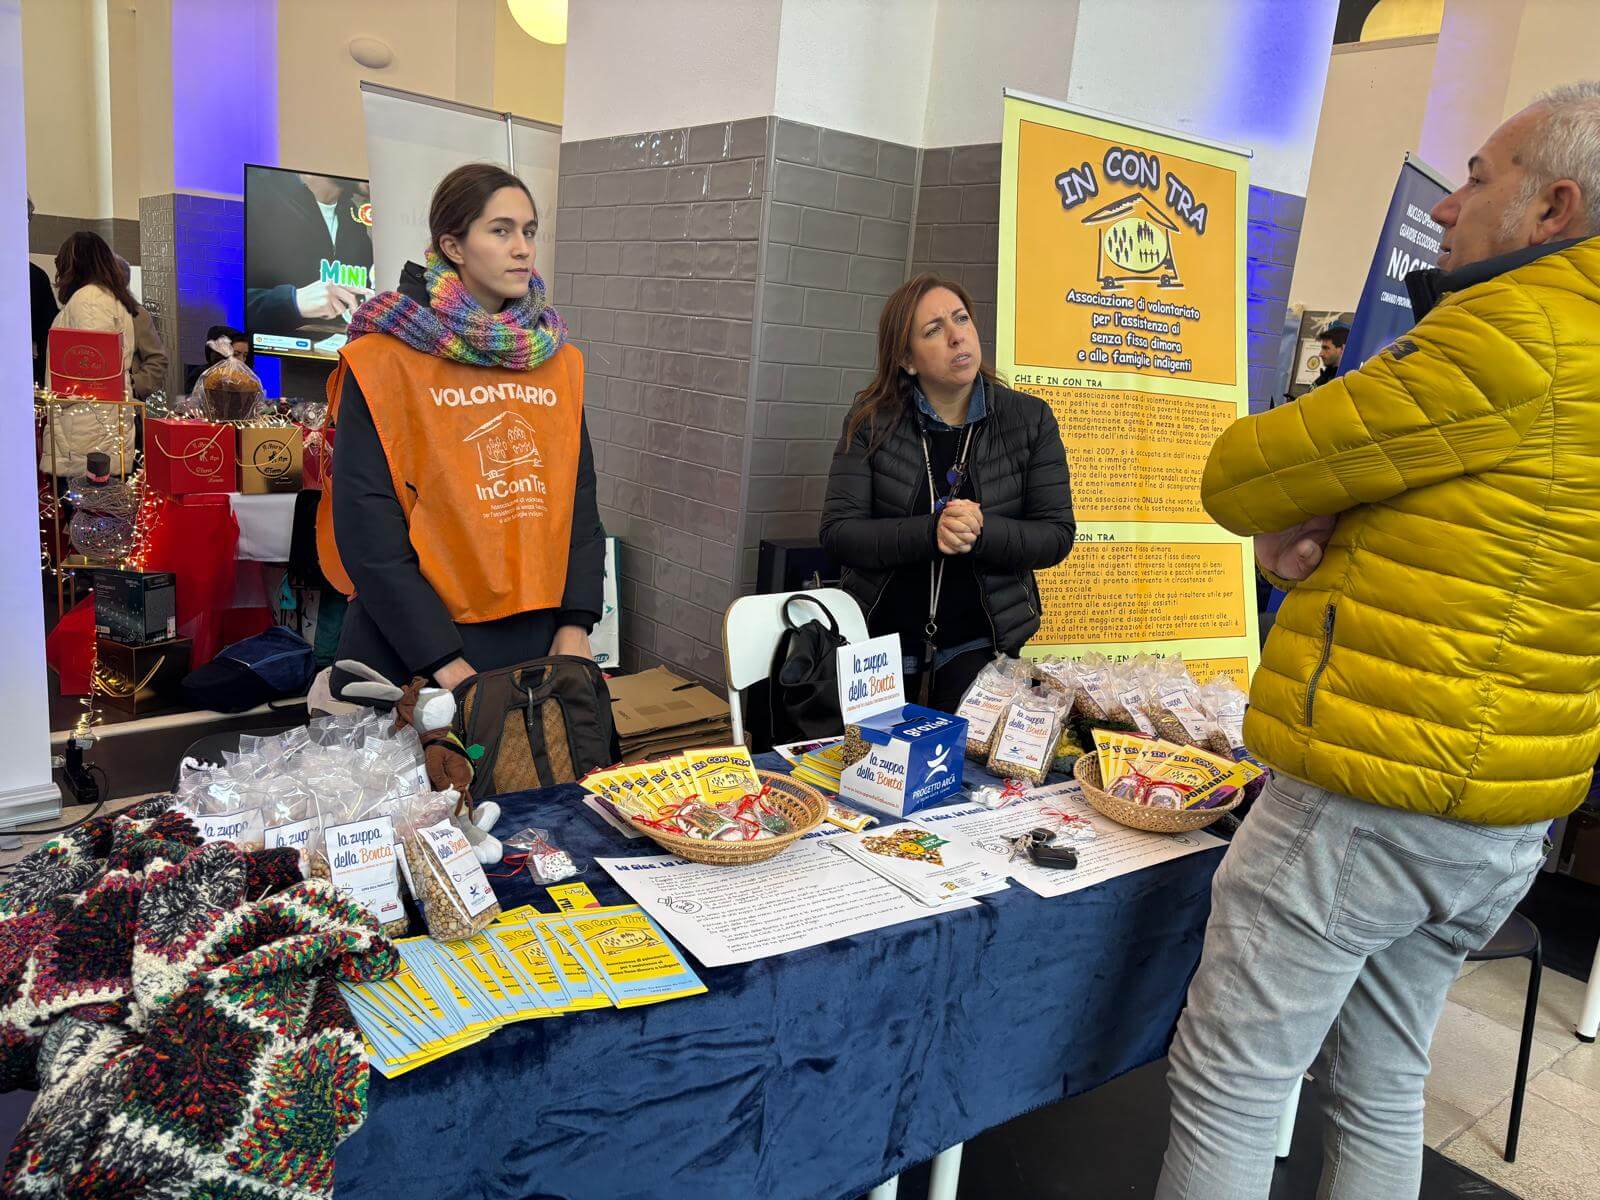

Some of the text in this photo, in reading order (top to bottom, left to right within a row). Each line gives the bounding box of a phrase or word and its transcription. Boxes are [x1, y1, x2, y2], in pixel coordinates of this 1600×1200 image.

[1056, 146, 1208, 236] IN CON TRA
[1066, 290, 1200, 320] Associazione di volontariato
[1092, 312, 1180, 334] per l'assistenza ai
[1091, 332, 1182, 353] senza fissa dimora
[1078, 350, 1192, 373] e alle famiglie indigenti
[1015, 374, 1031, 382] CHI
[1047, 376, 1058, 385] IN
[1063, 378, 1082, 386] CON
[429, 383, 557, 407] VOLONTARIO
[476, 474, 546, 500] InConTra
[854, 652, 888, 674] la zuppa
[849, 672, 896, 702] della Bontà
[692, 761, 707, 772] IN
[731, 758, 750, 766] TRA
[869, 752, 904, 775] la zuppa
[856, 764, 904, 791] della Bontà
[913, 781, 942, 800] PROGETTO
[276, 834, 287, 847] la
[338, 828, 382, 847] la zuppa
[334, 844, 392, 868] della Bontà
